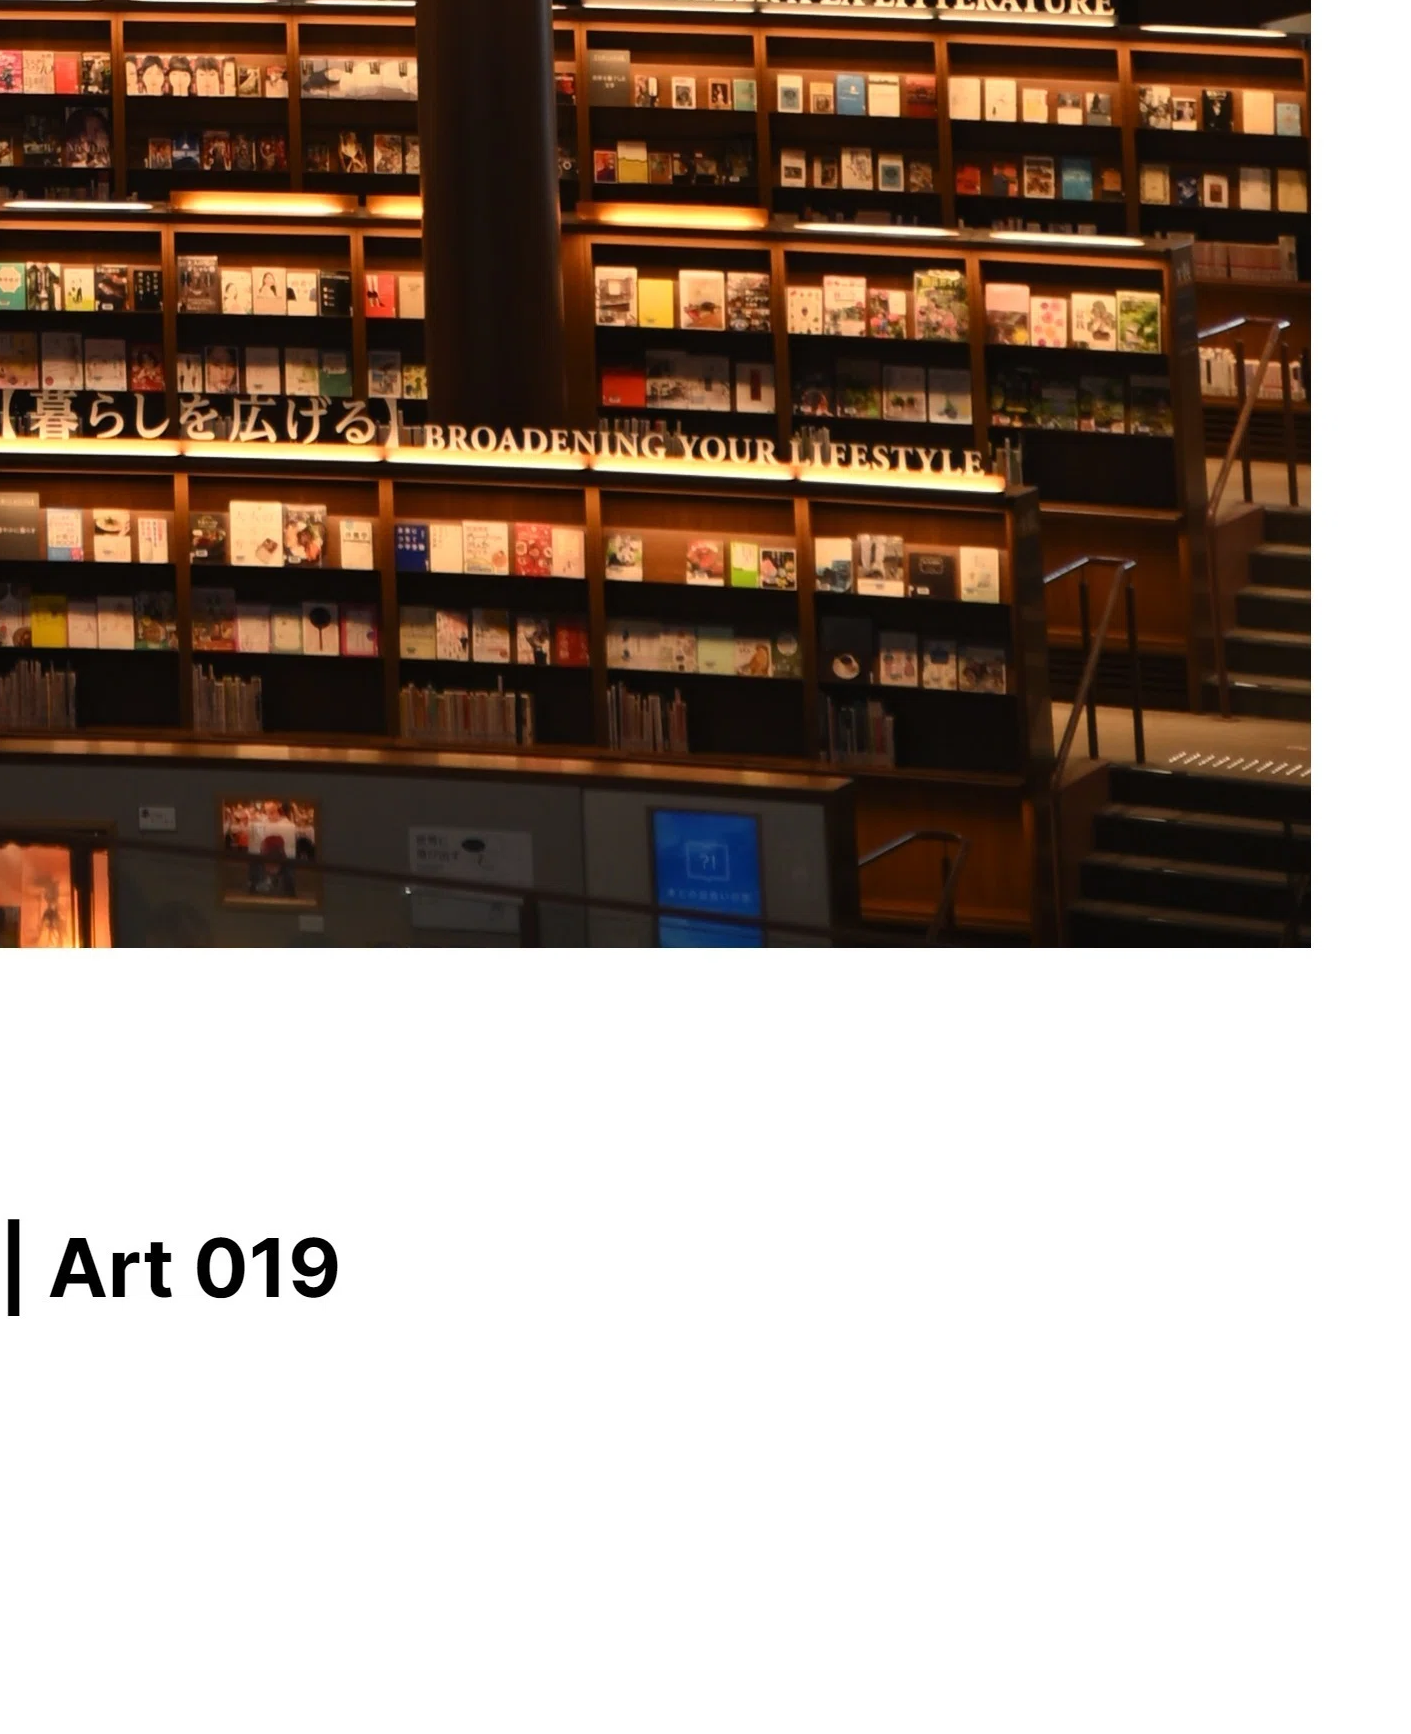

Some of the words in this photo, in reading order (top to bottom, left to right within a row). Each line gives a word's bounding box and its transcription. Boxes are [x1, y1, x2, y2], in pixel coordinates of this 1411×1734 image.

[424, 423, 668, 460] BROADENING
[678, 432, 779, 467] YOUR
[788, 437, 986, 478] LIFESTYLE
